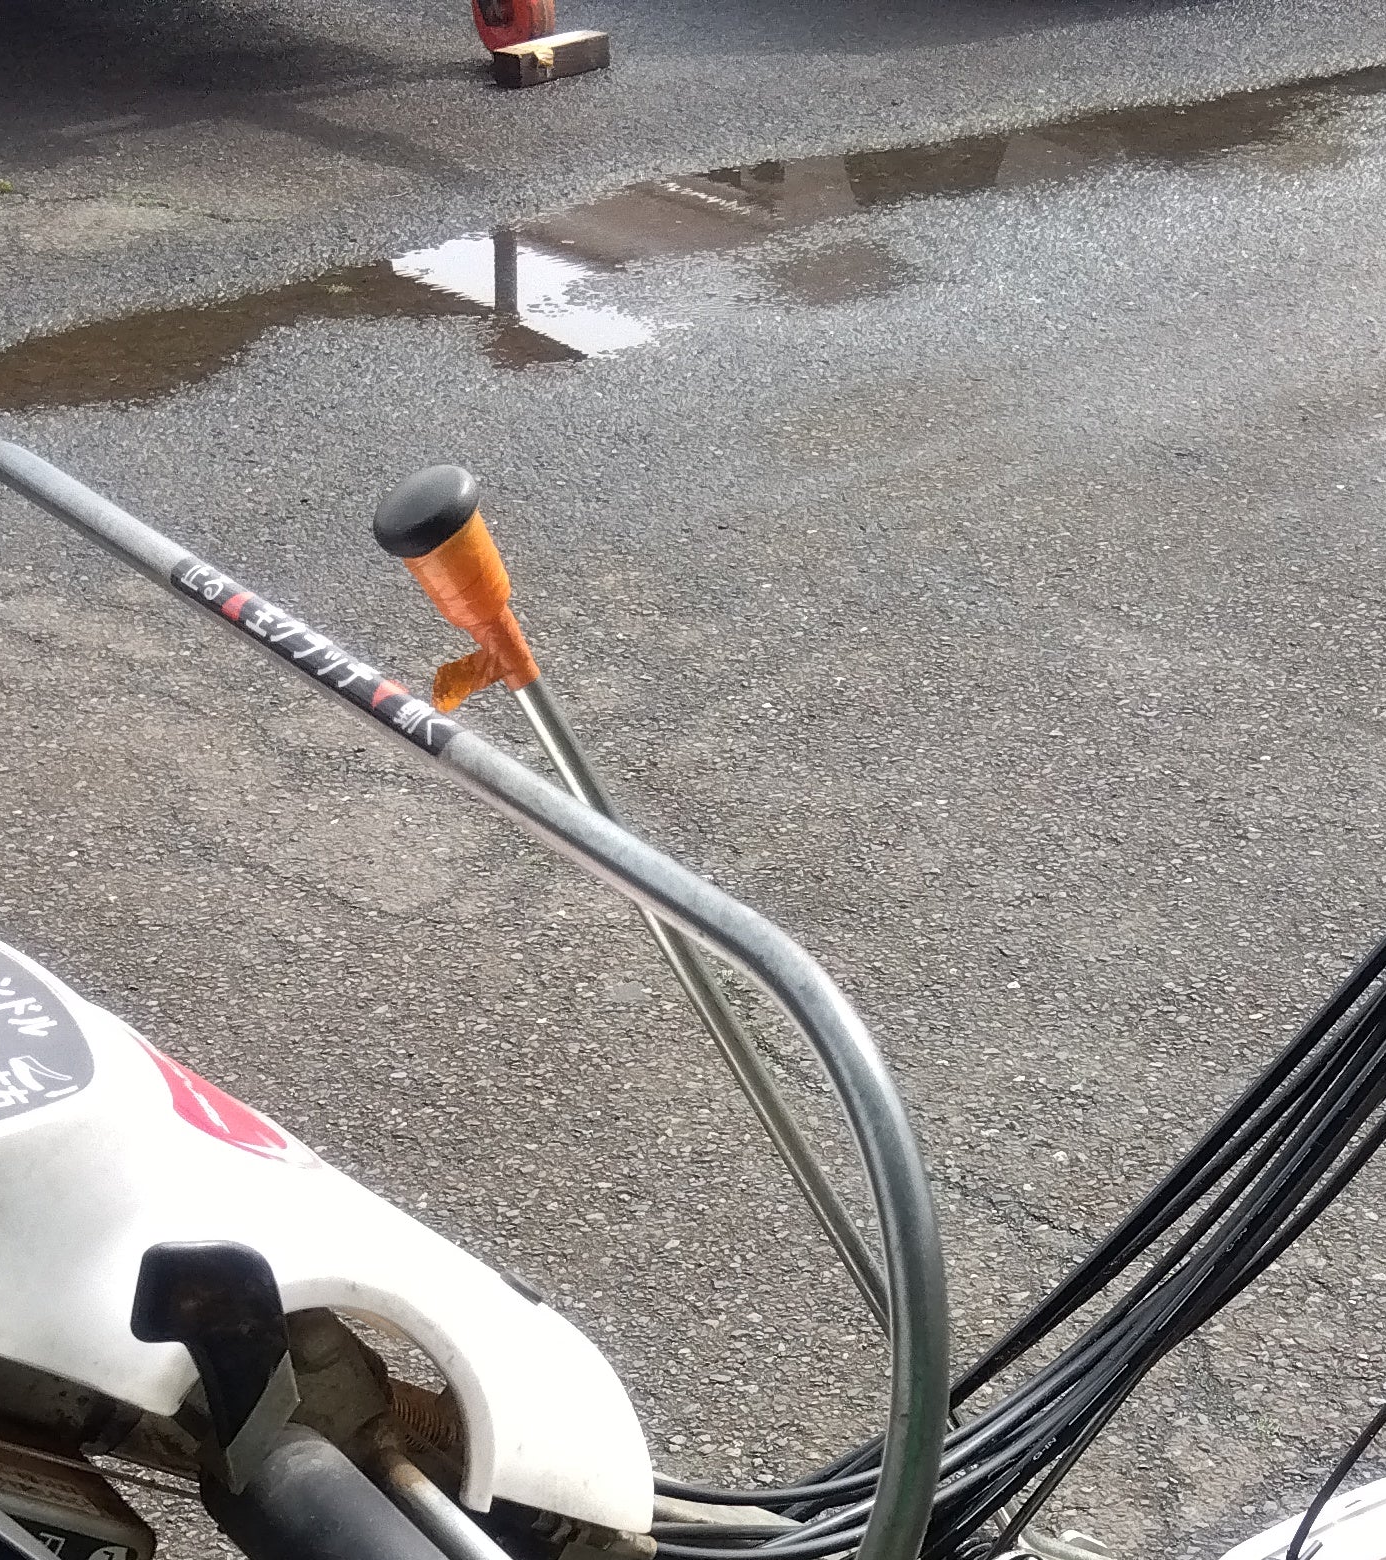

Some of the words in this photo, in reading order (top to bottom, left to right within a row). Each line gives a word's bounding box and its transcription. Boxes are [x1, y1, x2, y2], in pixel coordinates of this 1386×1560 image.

[246, 603, 381, 688] 主クラッチ
